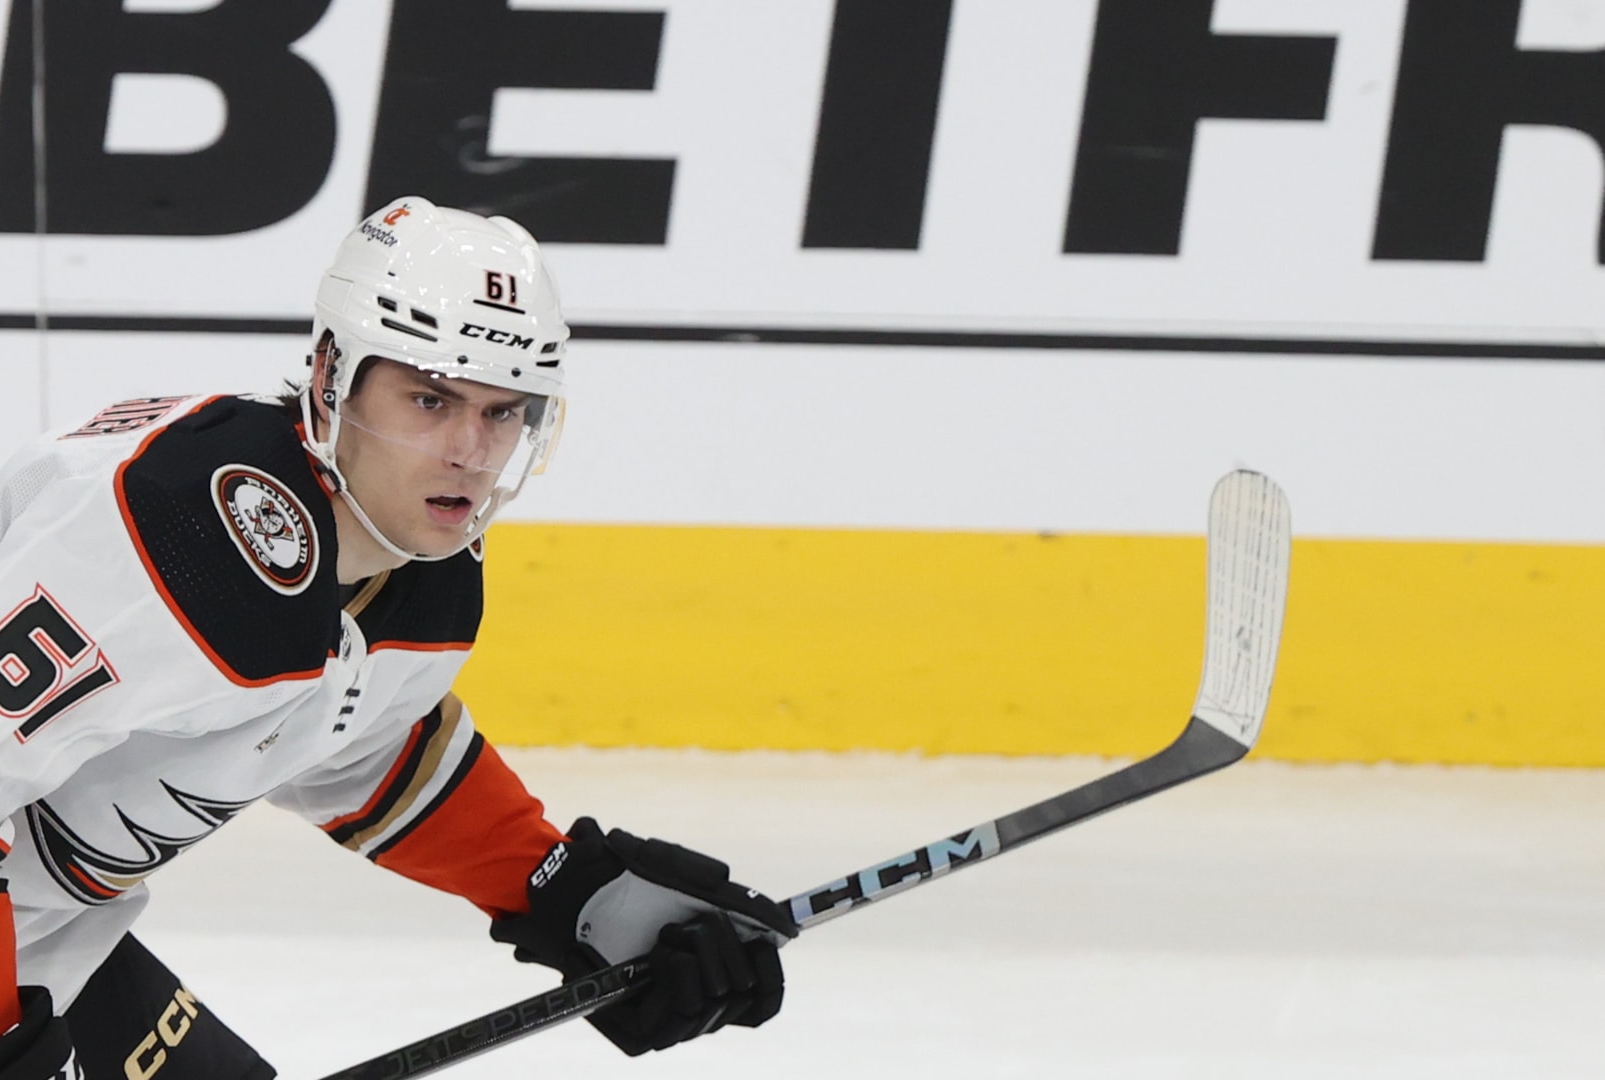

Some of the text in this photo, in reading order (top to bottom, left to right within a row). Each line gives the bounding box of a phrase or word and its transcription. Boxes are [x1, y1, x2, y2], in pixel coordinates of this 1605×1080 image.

[483, 270, 517, 305] 61
[459, 322, 535, 350] CCM
[227, 500, 272, 568] DUCKS
[245, 477, 308, 564] ANAHEIM
[530, 842, 565, 887] CCM
[791, 819, 1001, 930] CCM
